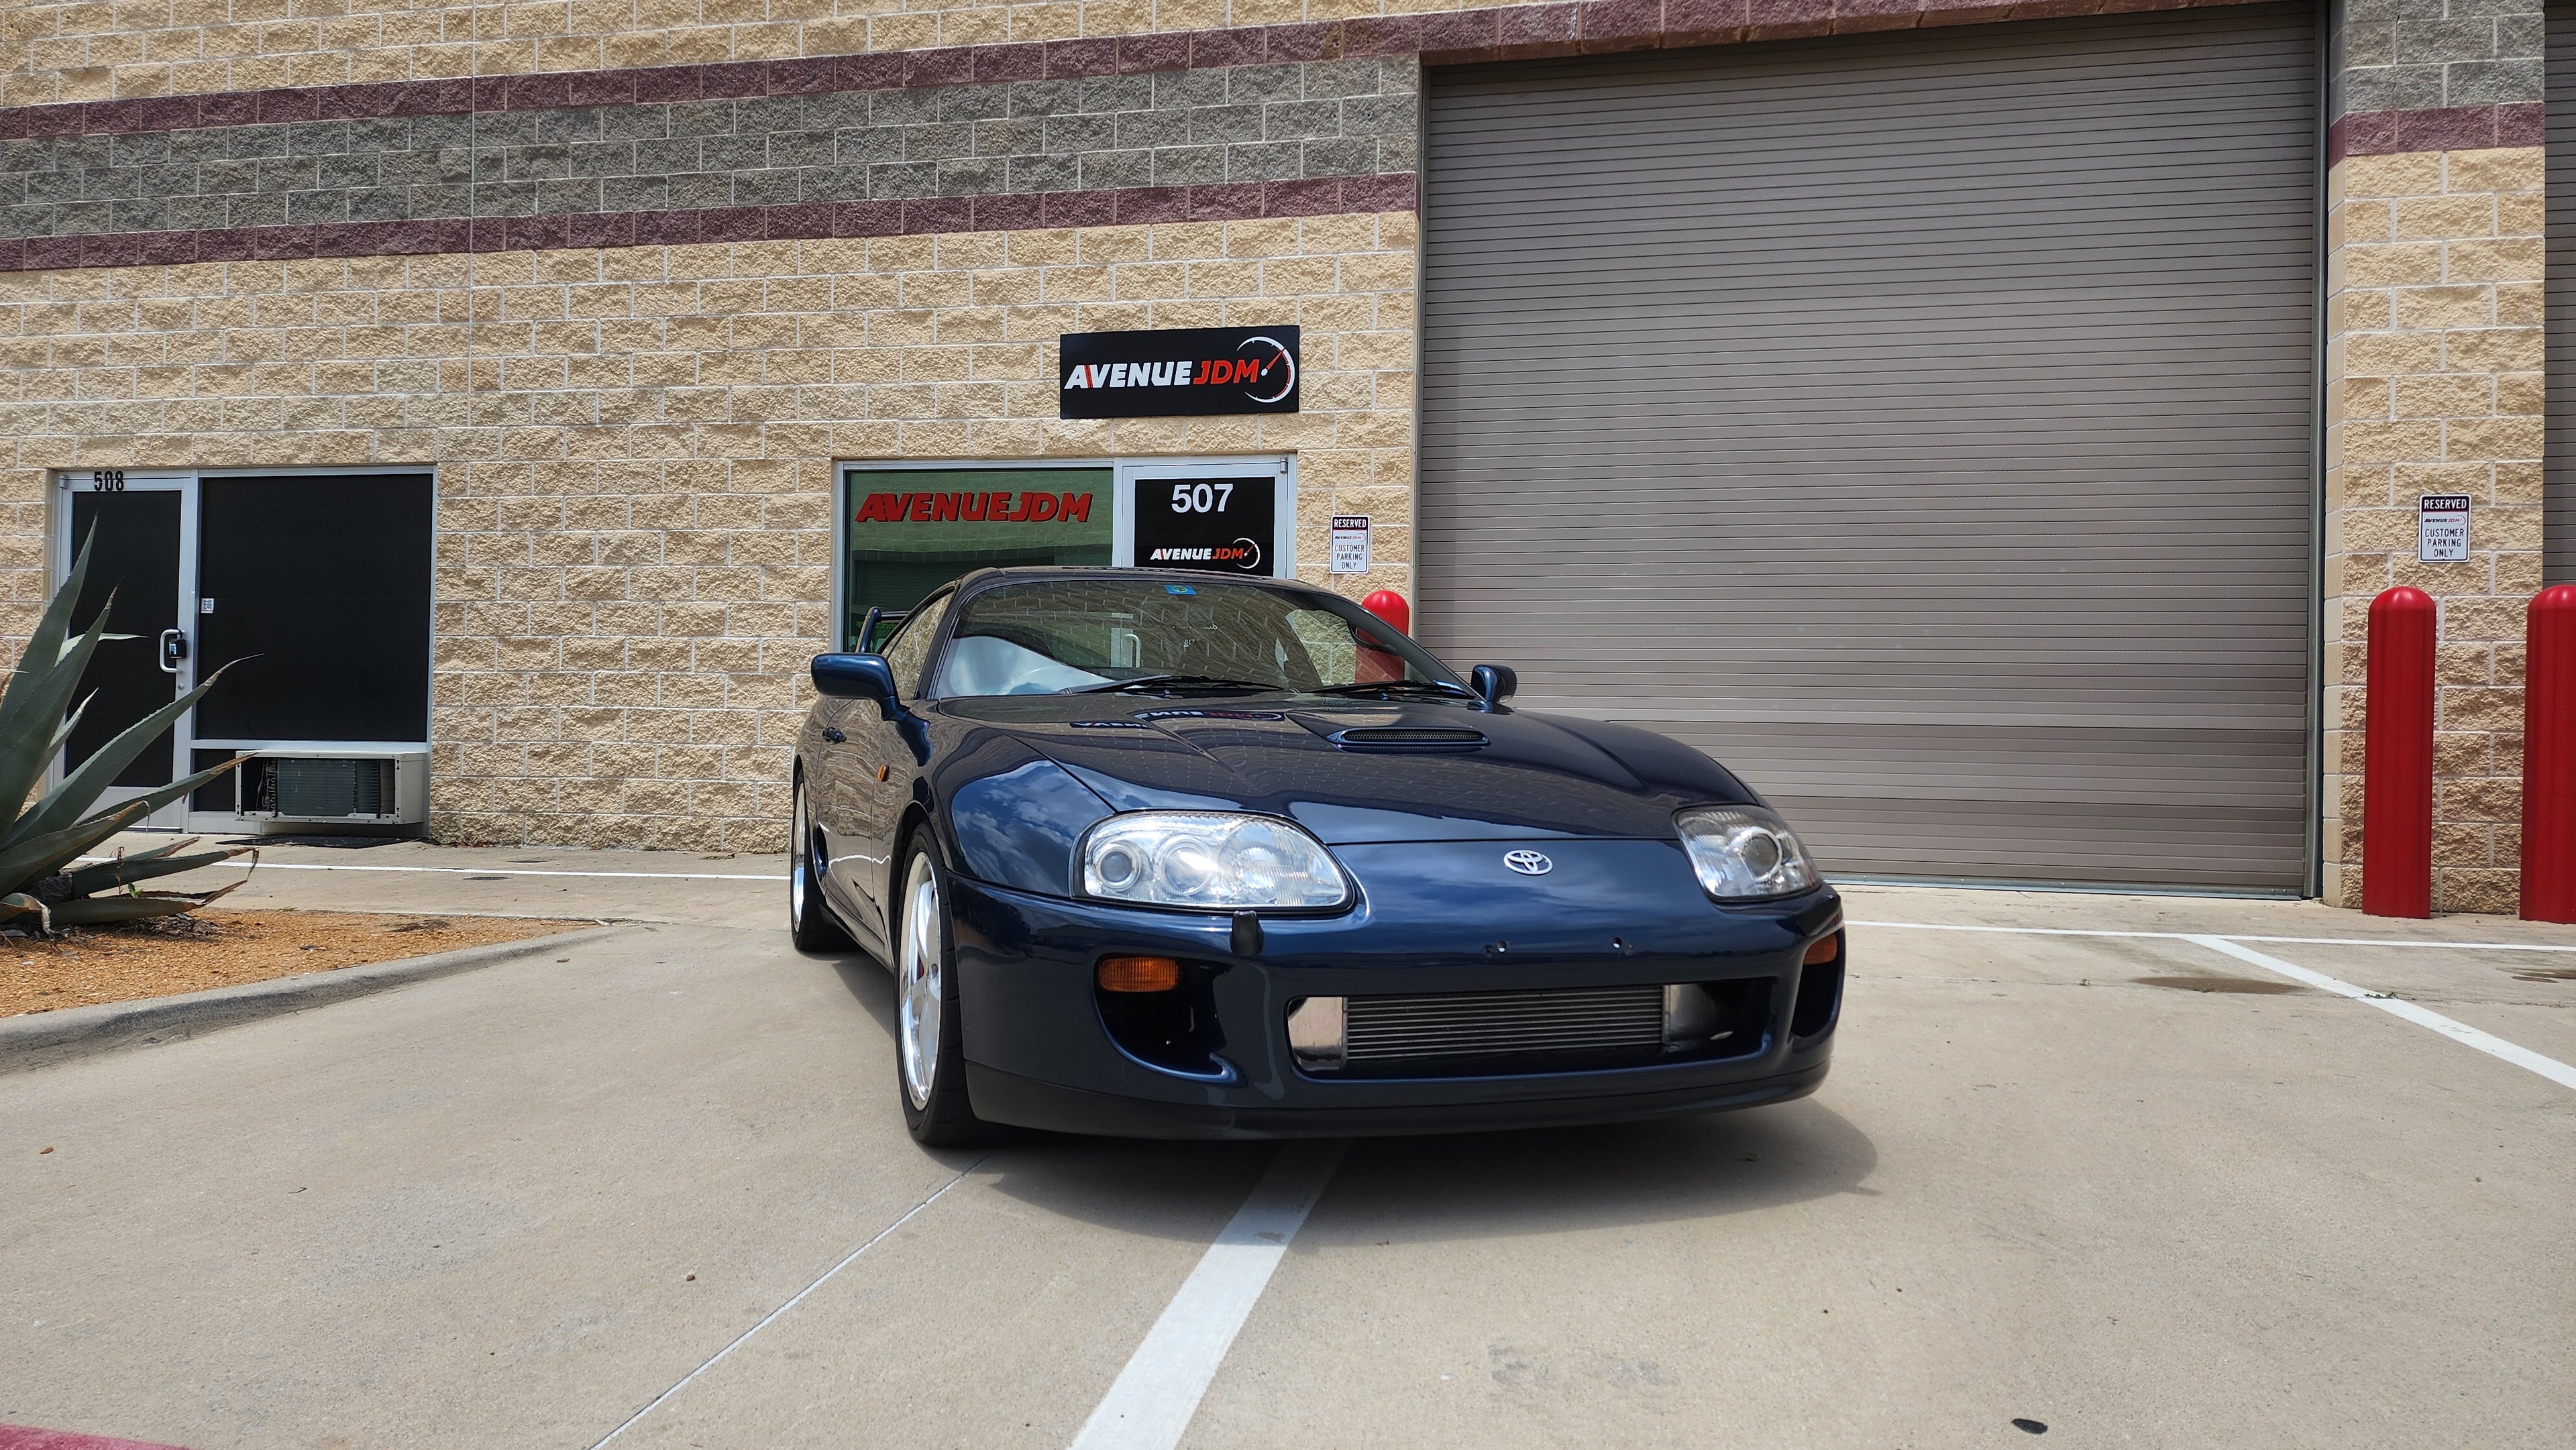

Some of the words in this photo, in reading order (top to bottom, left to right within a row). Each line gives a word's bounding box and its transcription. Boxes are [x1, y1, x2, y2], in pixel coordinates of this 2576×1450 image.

[94, 471, 124, 492] 508
[1172, 484, 1233, 513] 507
[2424, 499, 2467, 509] RESERVED
[1334, 519, 1366, 528] RESERVED
[2425, 528, 2464, 537] CUSTOMER
[2427, 539, 2461, 547] PARKING
[2434, 549, 2454, 557] ONLY
